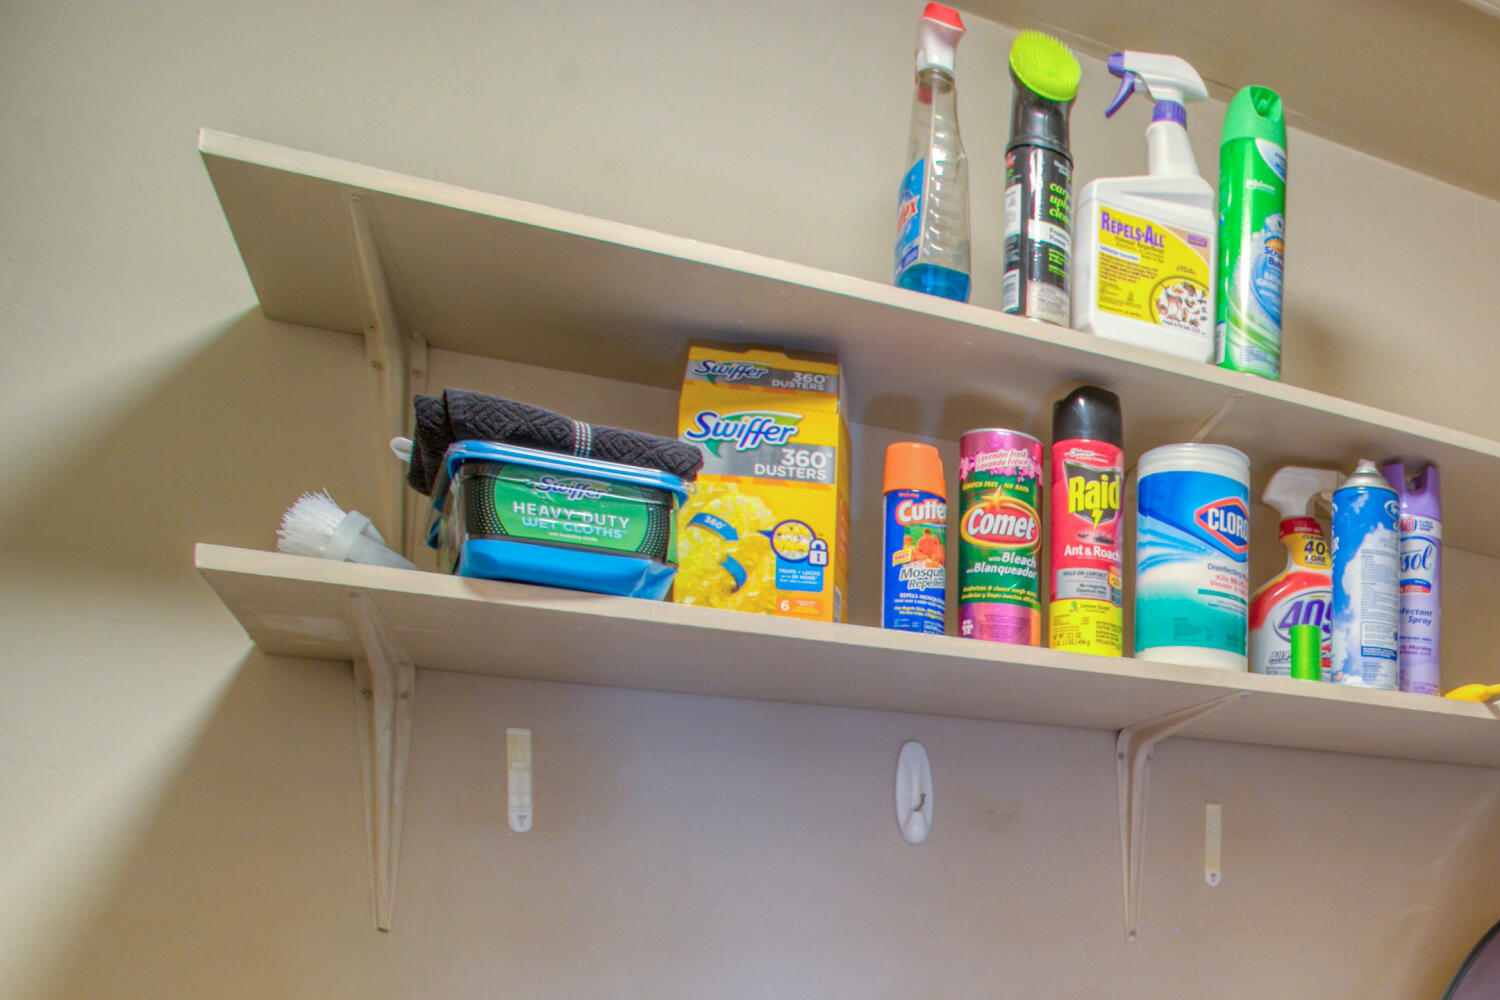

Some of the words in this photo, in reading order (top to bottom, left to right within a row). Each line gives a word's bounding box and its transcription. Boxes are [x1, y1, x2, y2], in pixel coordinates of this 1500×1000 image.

[694, 360, 768, 381] Swiffer
[772, 379, 824, 391] DUSTERS
[685, 411, 798, 451] Swiffer
[754, 464, 827, 480] DUSTERS
[534, 475, 603, 500] Swiffer
[1069, 474, 1120, 514] Raid
[512, 501, 574, 520] HEAVY
[581, 511, 630, 528] DUTY
[521, 516, 558, 529] WET
[968, 508, 1035, 540] Comet
[1002, 551, 1036, 567] Bleach
[1064, 545, 1083, 556] Ant
[1084, 548, 1093, 556] &
[1094, 546, 1120, 561] Roach
[974, 562, 1037, 580] Blanqueador
[780, 600, 790, 611] 6
[1407, 614, 1433, 627] Spray
